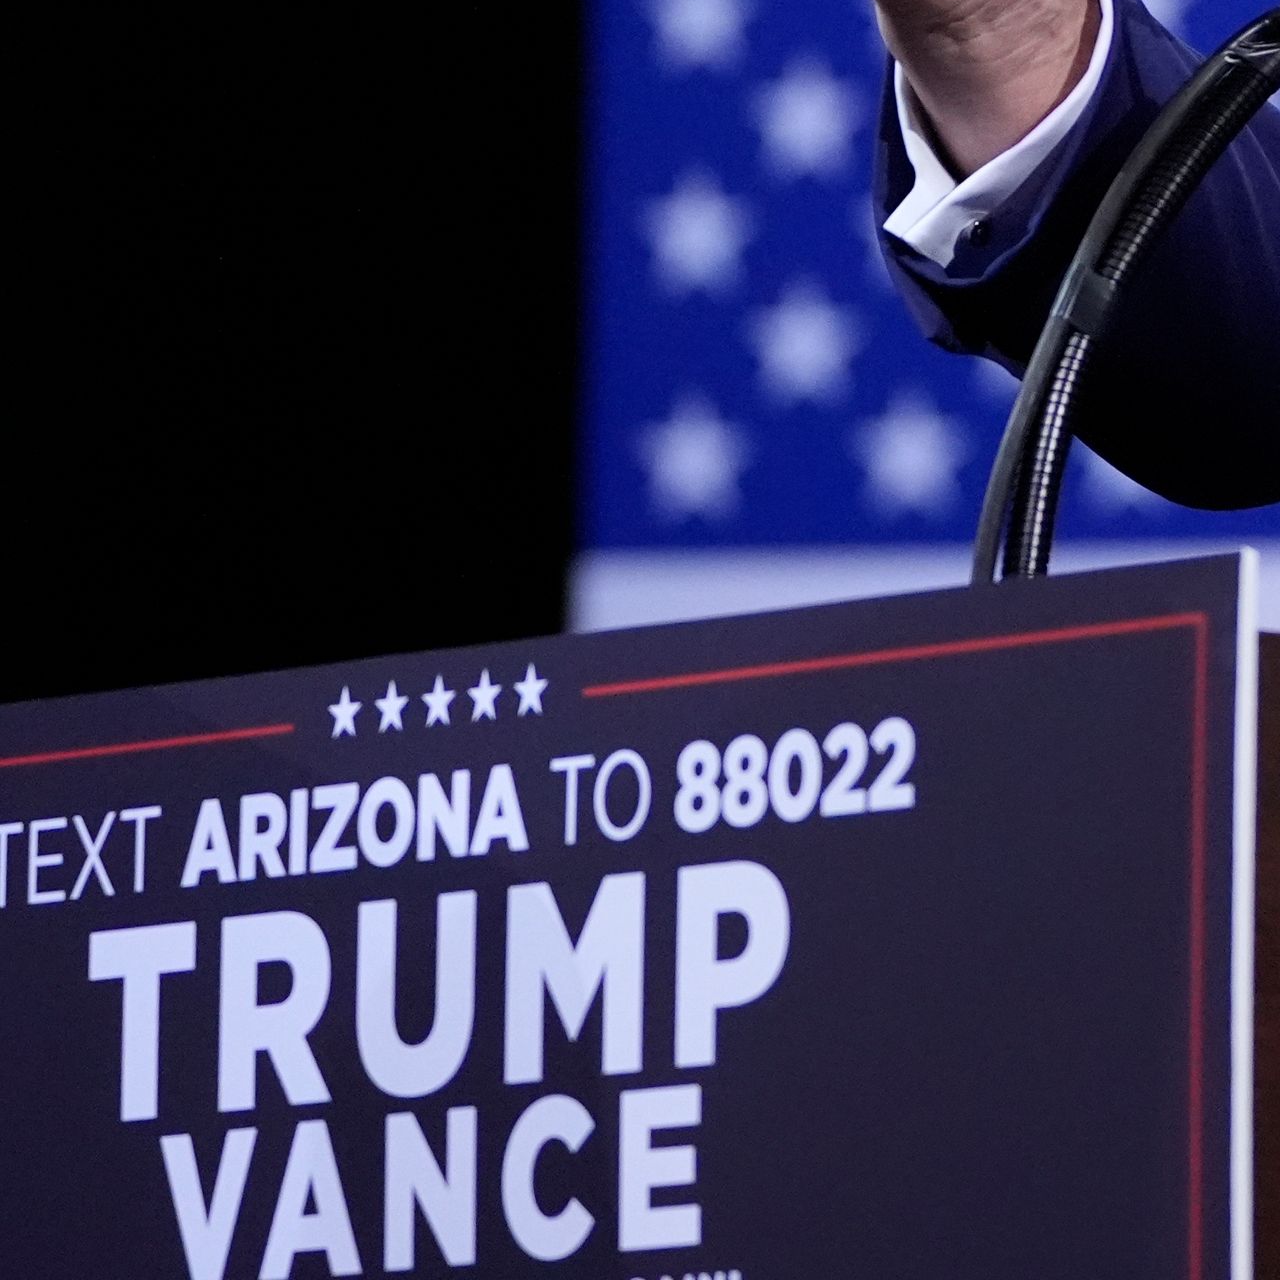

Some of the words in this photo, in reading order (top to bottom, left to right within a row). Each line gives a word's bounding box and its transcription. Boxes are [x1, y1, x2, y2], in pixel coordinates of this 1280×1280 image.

[0, 804, 162, 909] TEXT
[179, 763, 530, 889] ARIZONA
[549, 748, 652, 846] TO
[673, 715, 917, 834] 88022
[88, 860, 792, 1122] TRUMP
[159, 1083, 703, 1280] VANCE
